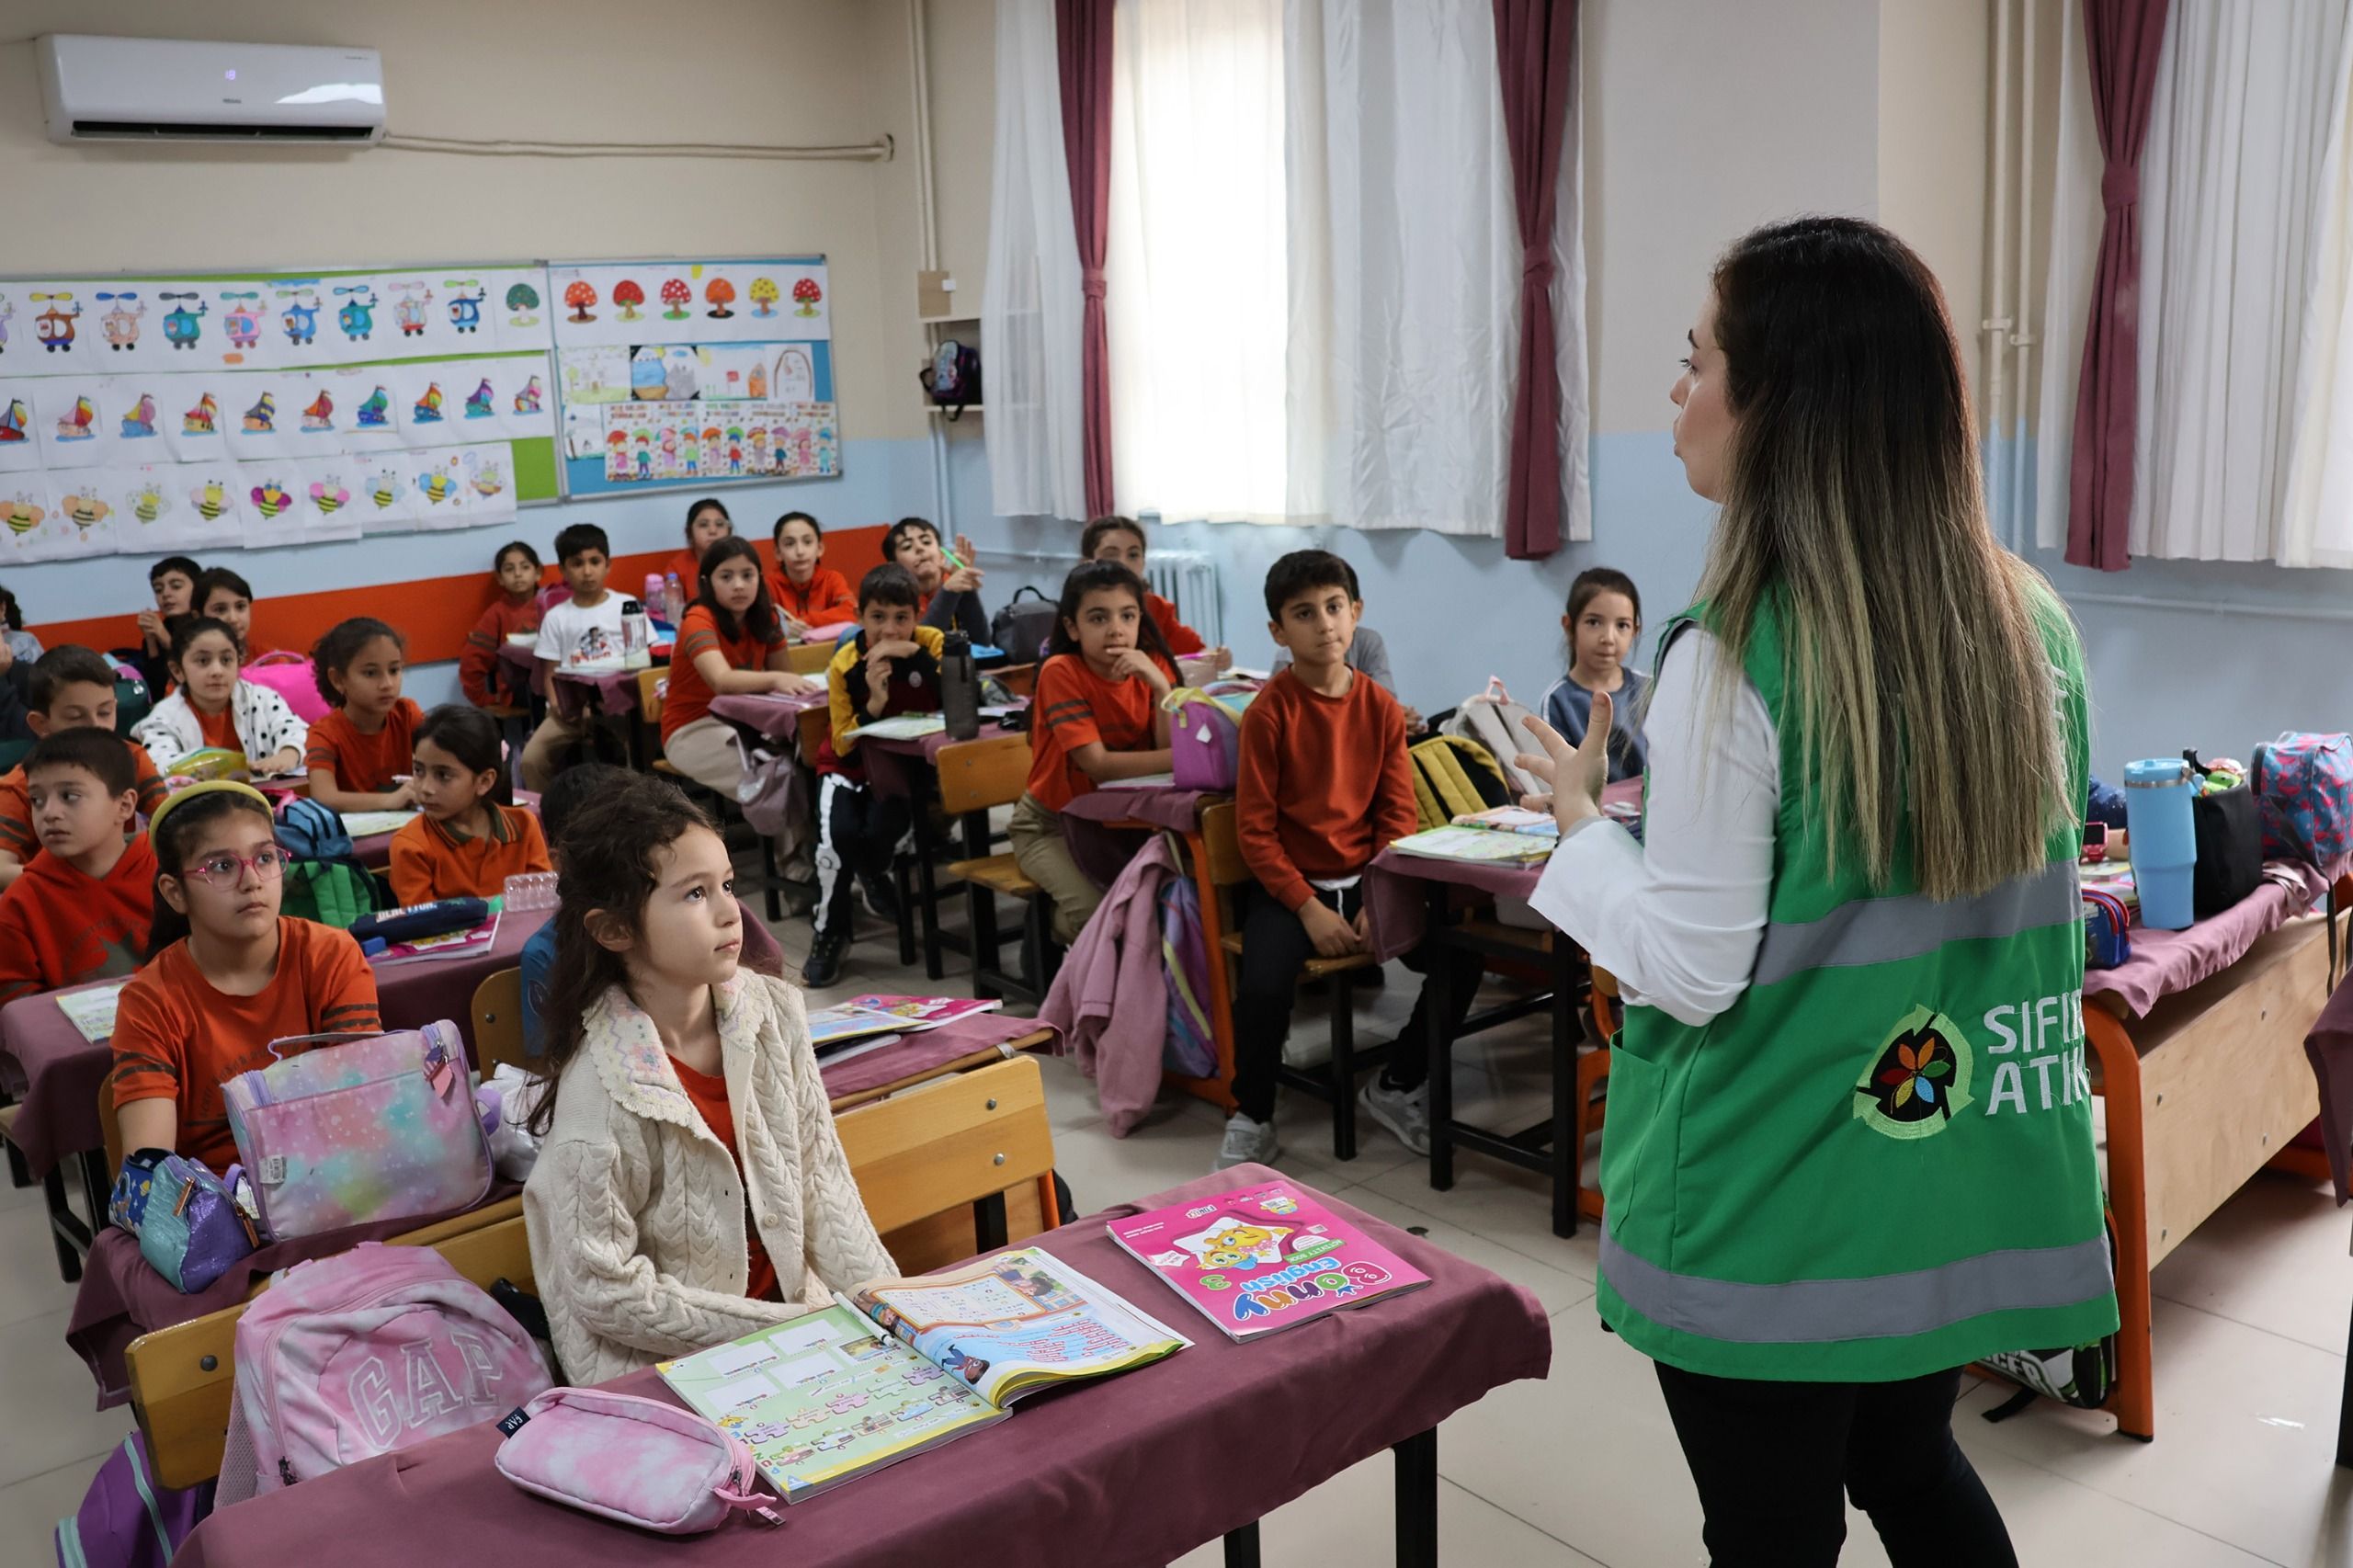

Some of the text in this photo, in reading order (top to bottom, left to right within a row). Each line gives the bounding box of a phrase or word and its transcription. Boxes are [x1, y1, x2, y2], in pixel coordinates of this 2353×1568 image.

[1985, 1046, 2089, 1116] ATIK
[1199, 1275, 1232, 1290] 3
[1233, 1261, 1392, 1322] Bonny
[1241, 1257, 1342, 1291] English
[348, 1333, 503, 1449] GAP
[507, 1415, 523, 1430] GAP
